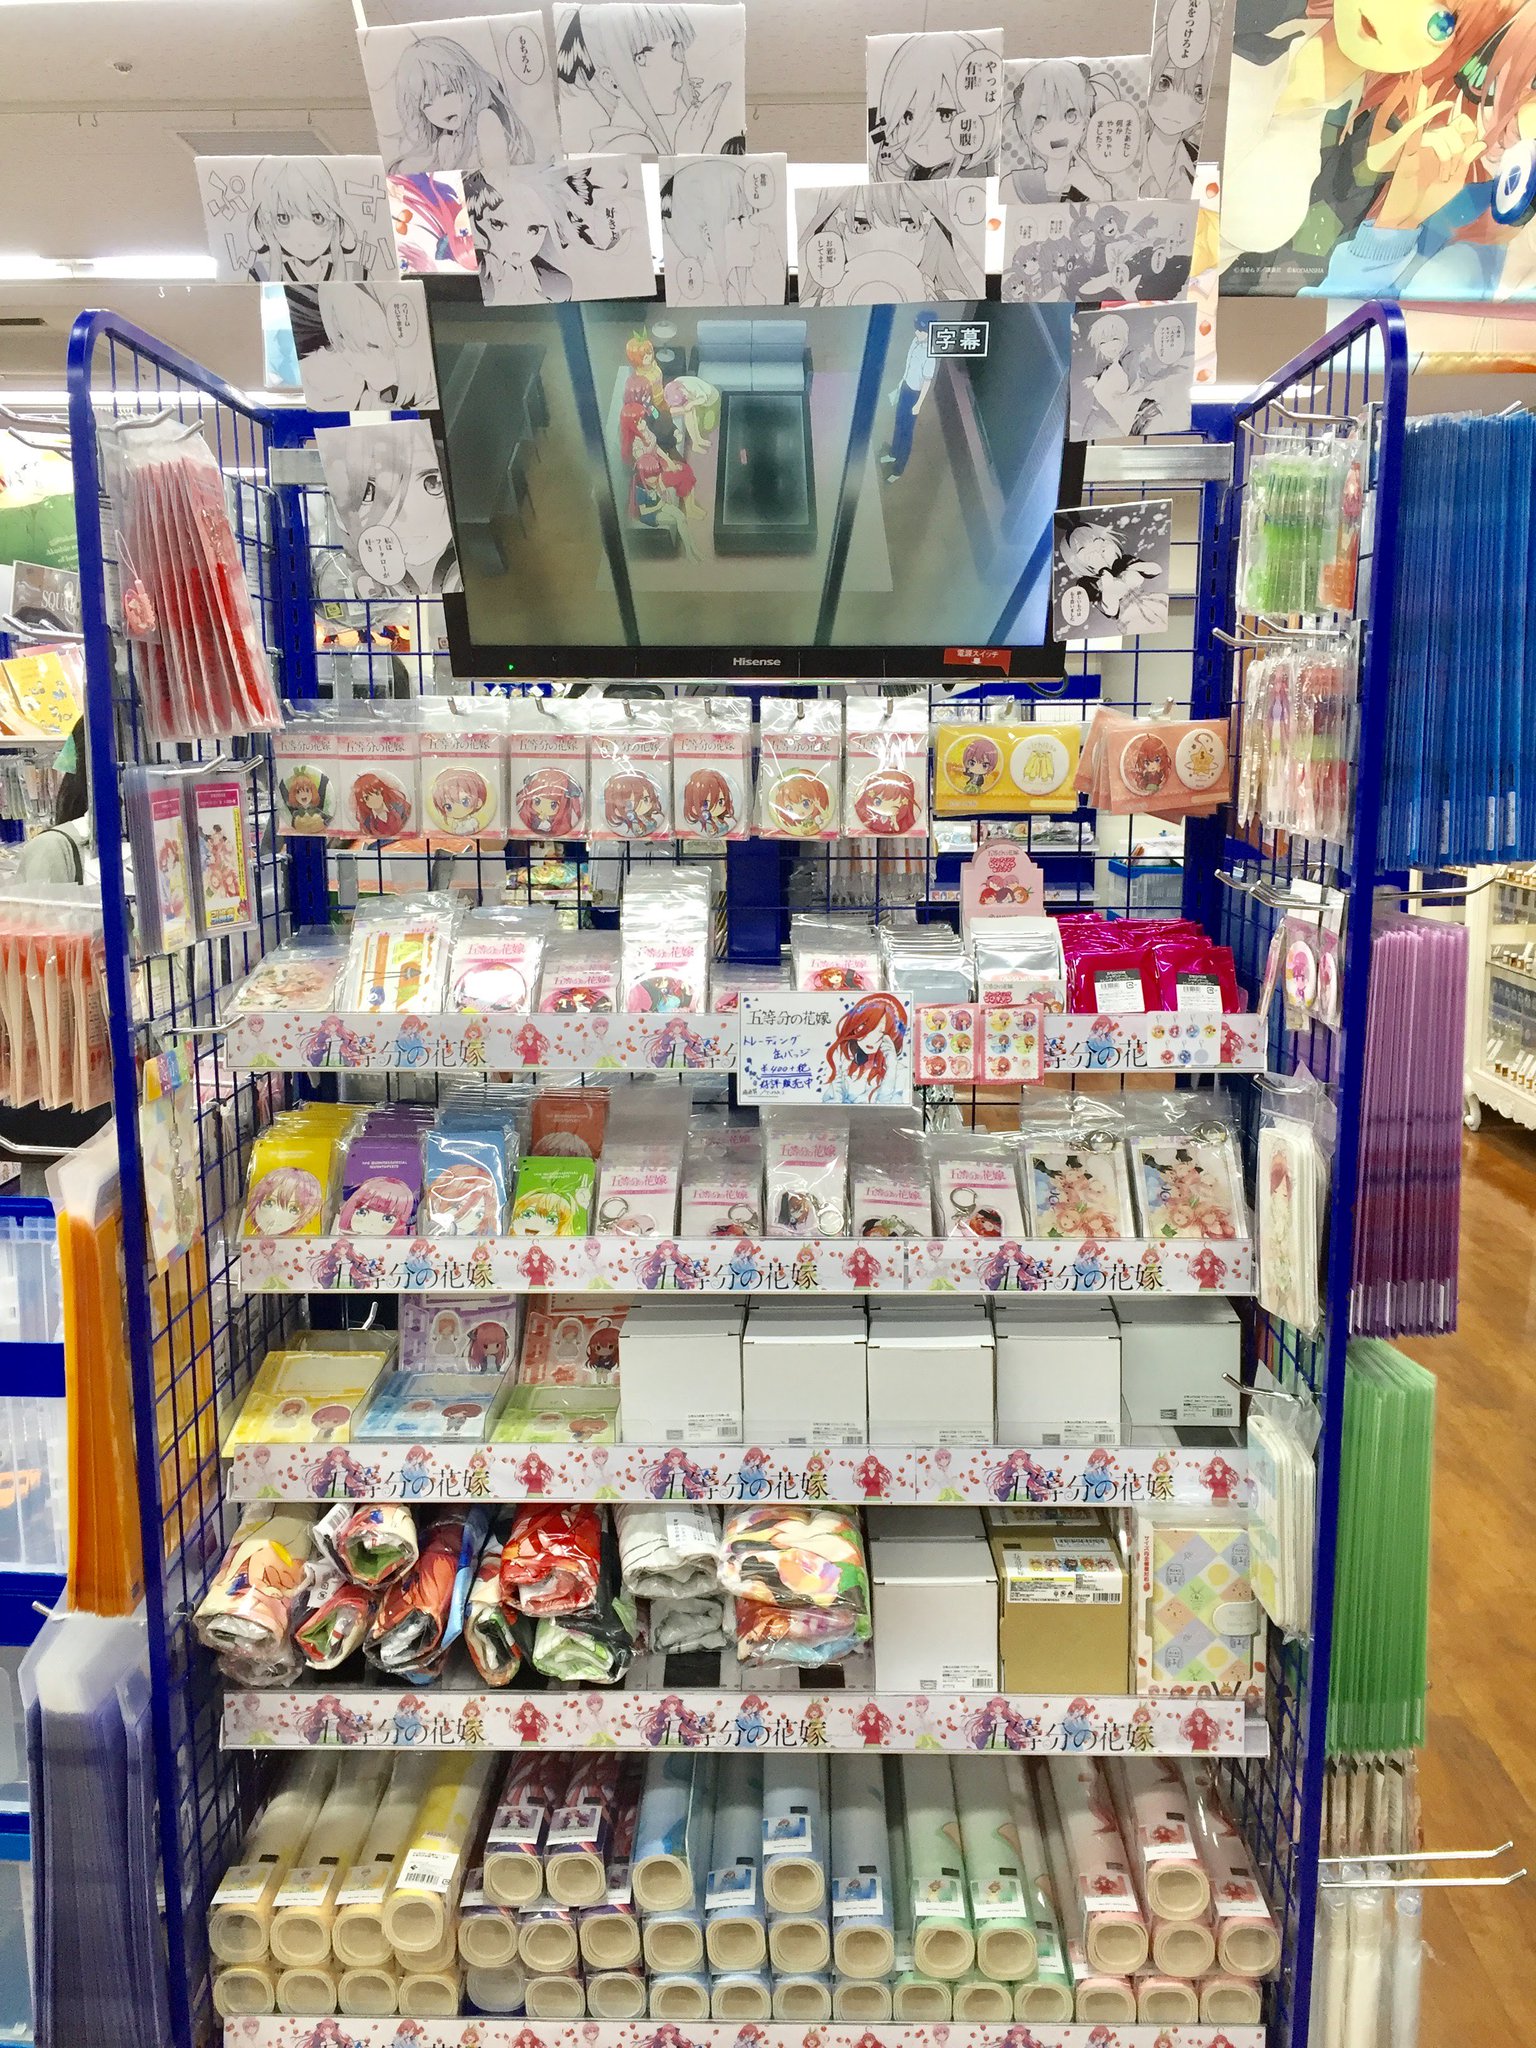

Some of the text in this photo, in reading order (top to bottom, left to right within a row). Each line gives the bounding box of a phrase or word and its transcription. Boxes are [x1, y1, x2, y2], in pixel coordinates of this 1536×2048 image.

[518, 35, 531, 74] もちろん
[964, 60, 977, 91] 有罪
[985, 60, 997, 103] やっぱ
[959, 118, 972, 147] 切腹
[1104, 120, 1114, 158] やっちゃい
[1123, 119, 1133, 157] またあたし
[605, 207, 619, 241] 好きよ
[936, 327, 981, 350] 字幕
[733, 657, 781, 667] Hisense
[956, 648, 999, 658] 電源スイッチ
[746, 1008, 832, 1026] 五等分の花嫁
[743, 1034, 801, 1046] トレーディング
[772, 1047, 812, 1060] 缶バッジ
[759, 1077, 813, 1089] 好評販売中
